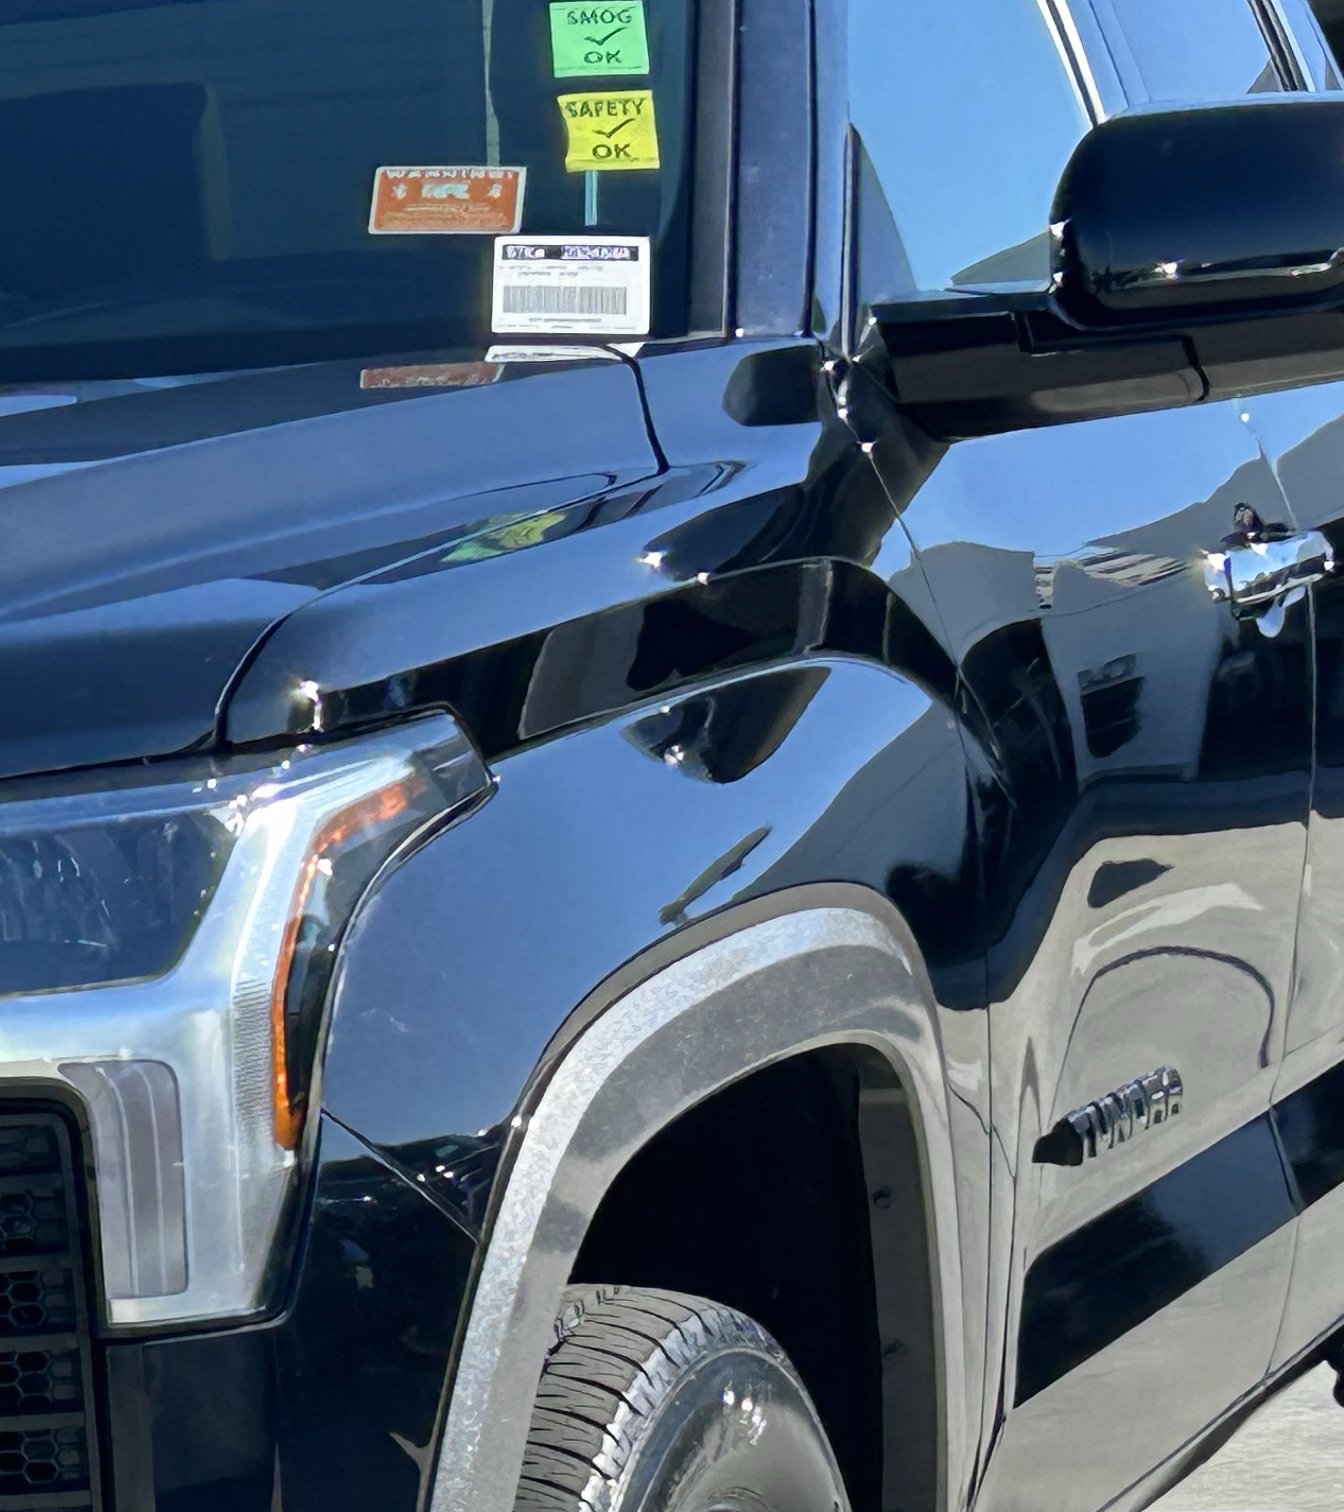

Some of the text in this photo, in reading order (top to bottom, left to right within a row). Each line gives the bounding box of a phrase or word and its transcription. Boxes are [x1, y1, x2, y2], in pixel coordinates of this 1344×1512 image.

[567, 9, 632, 26] SMOG
[583, 50, 622, 65] OK
[566, 98, 645, 118] SAFETY
[592, 143, 632, 161] OK
